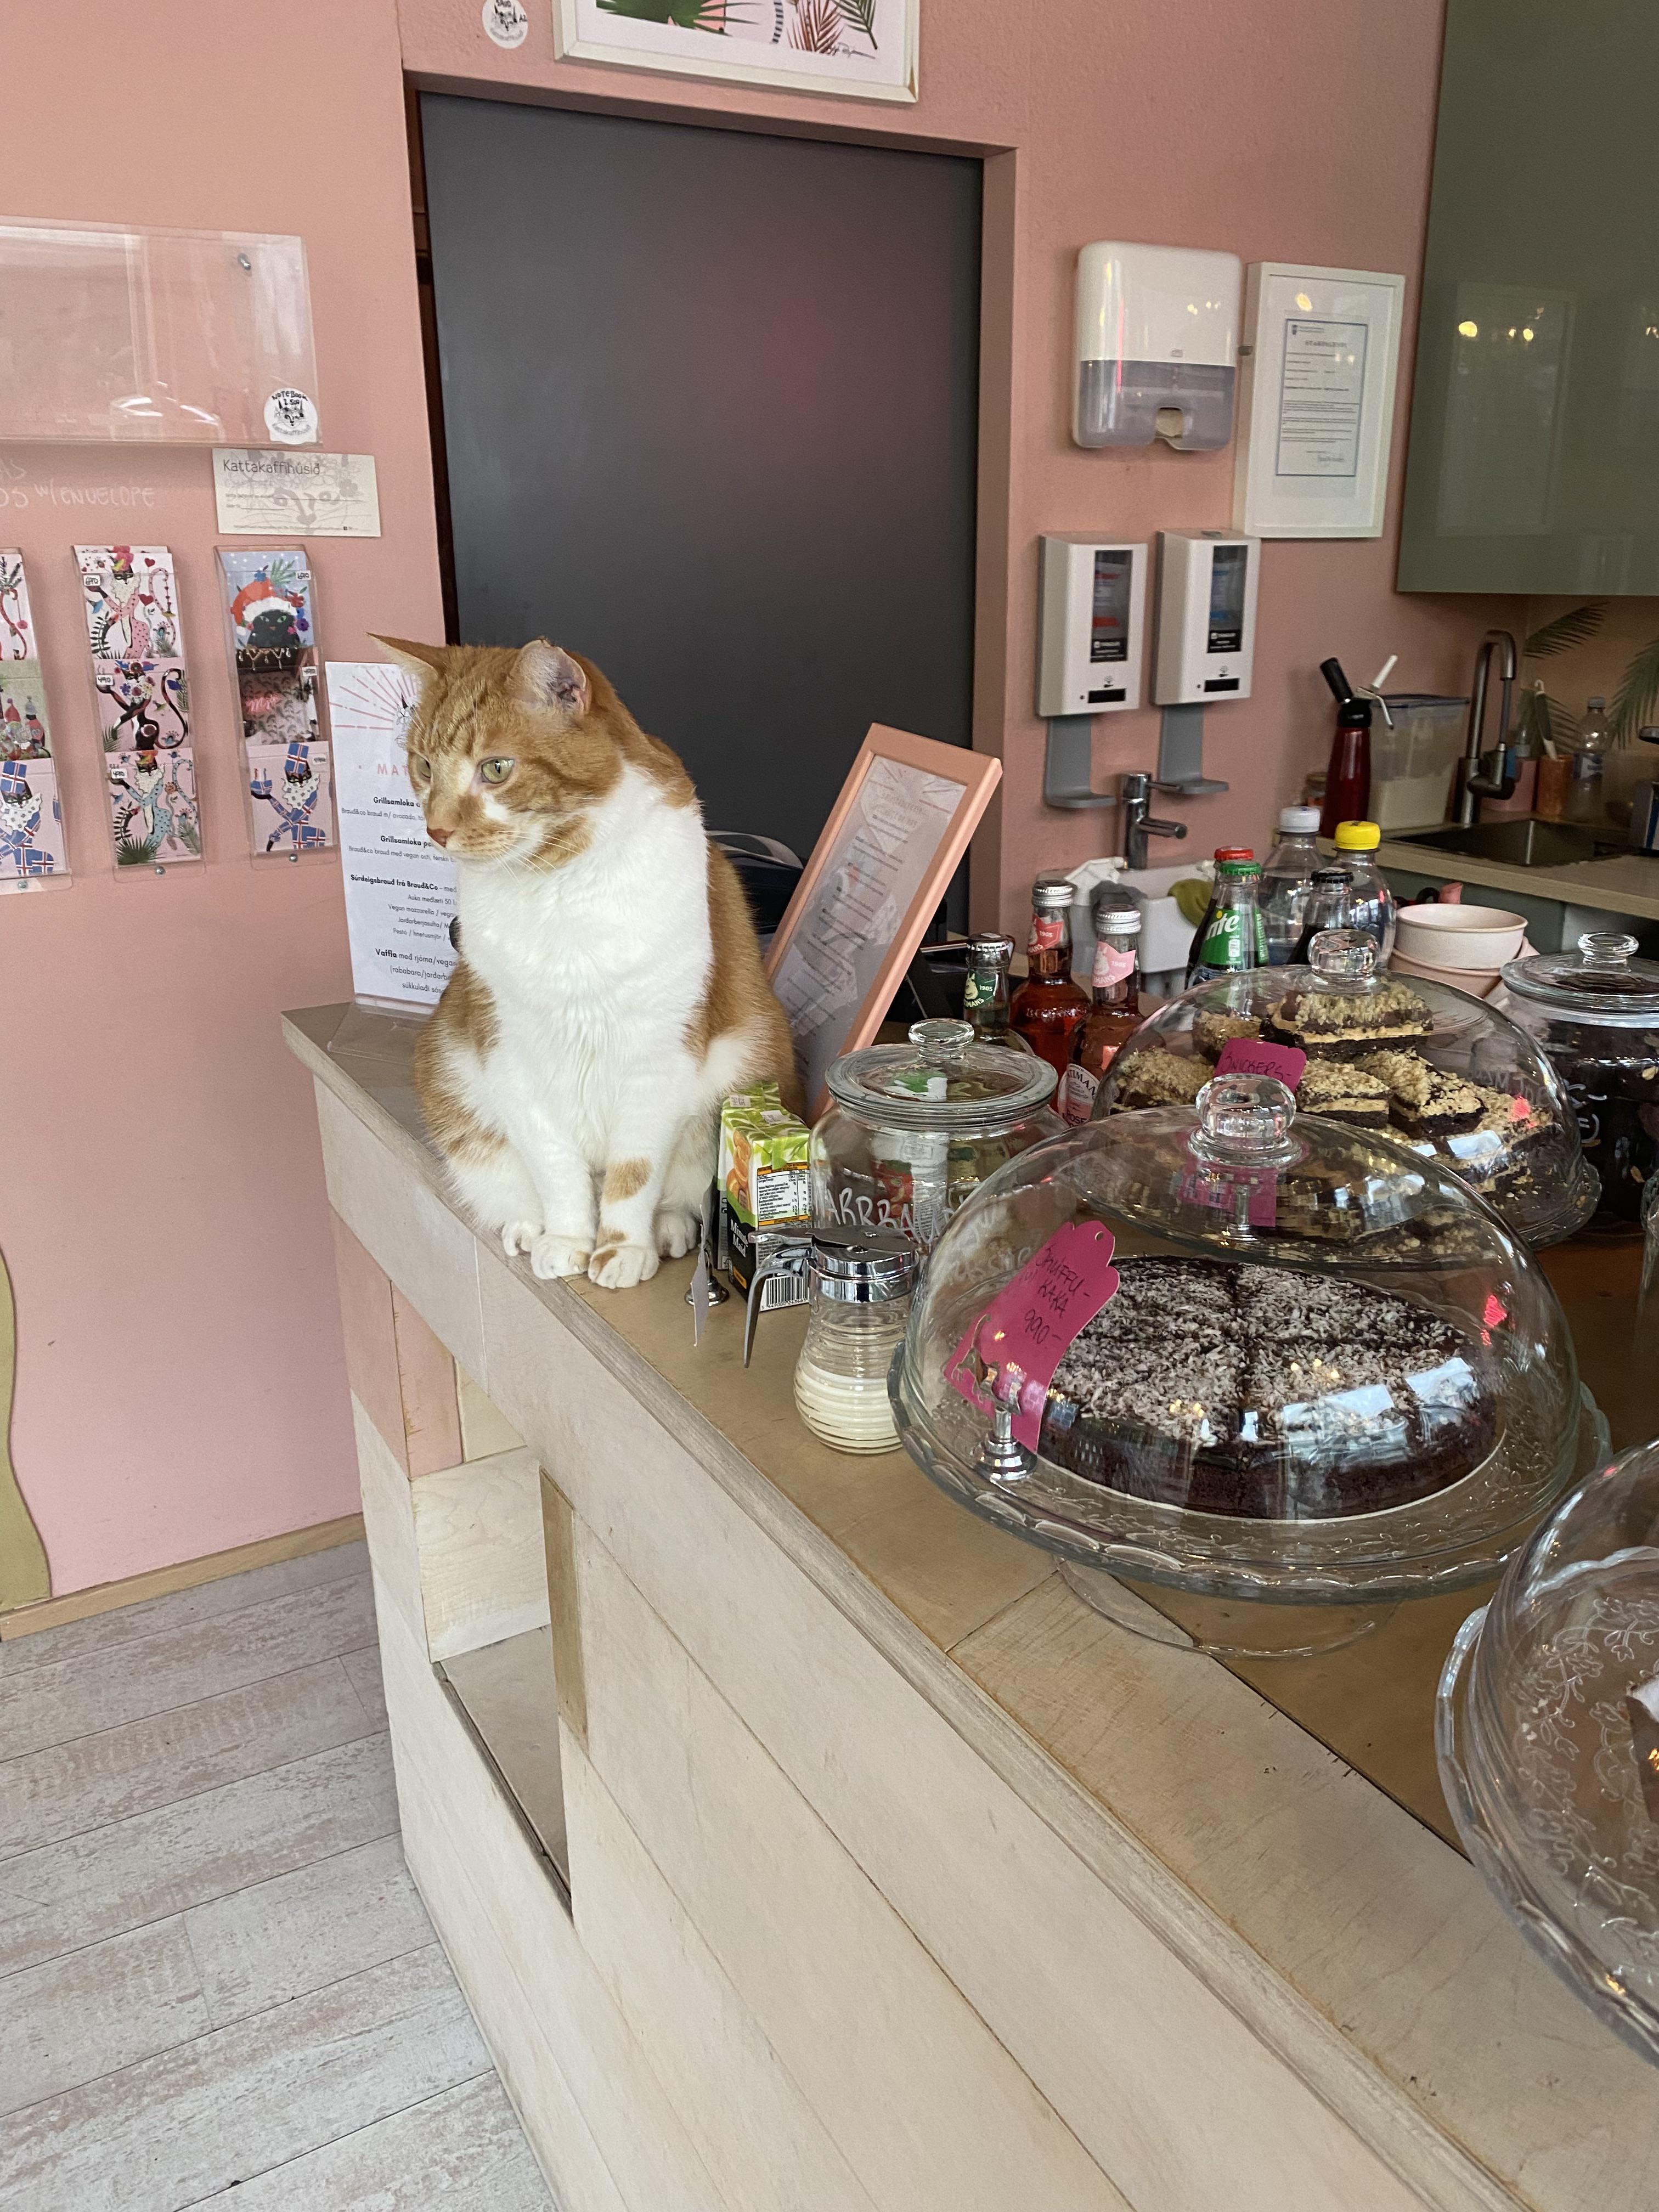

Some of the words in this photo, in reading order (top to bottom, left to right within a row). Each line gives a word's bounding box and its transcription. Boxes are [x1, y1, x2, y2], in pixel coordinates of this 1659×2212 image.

[272, 390, 308, 402] NOTEBOOK
[374, 797, 414, 807] Grillsamloka
[381, 836, 421, 846] Grillsamloka
[375, 948, 397, 958] Vaffla
